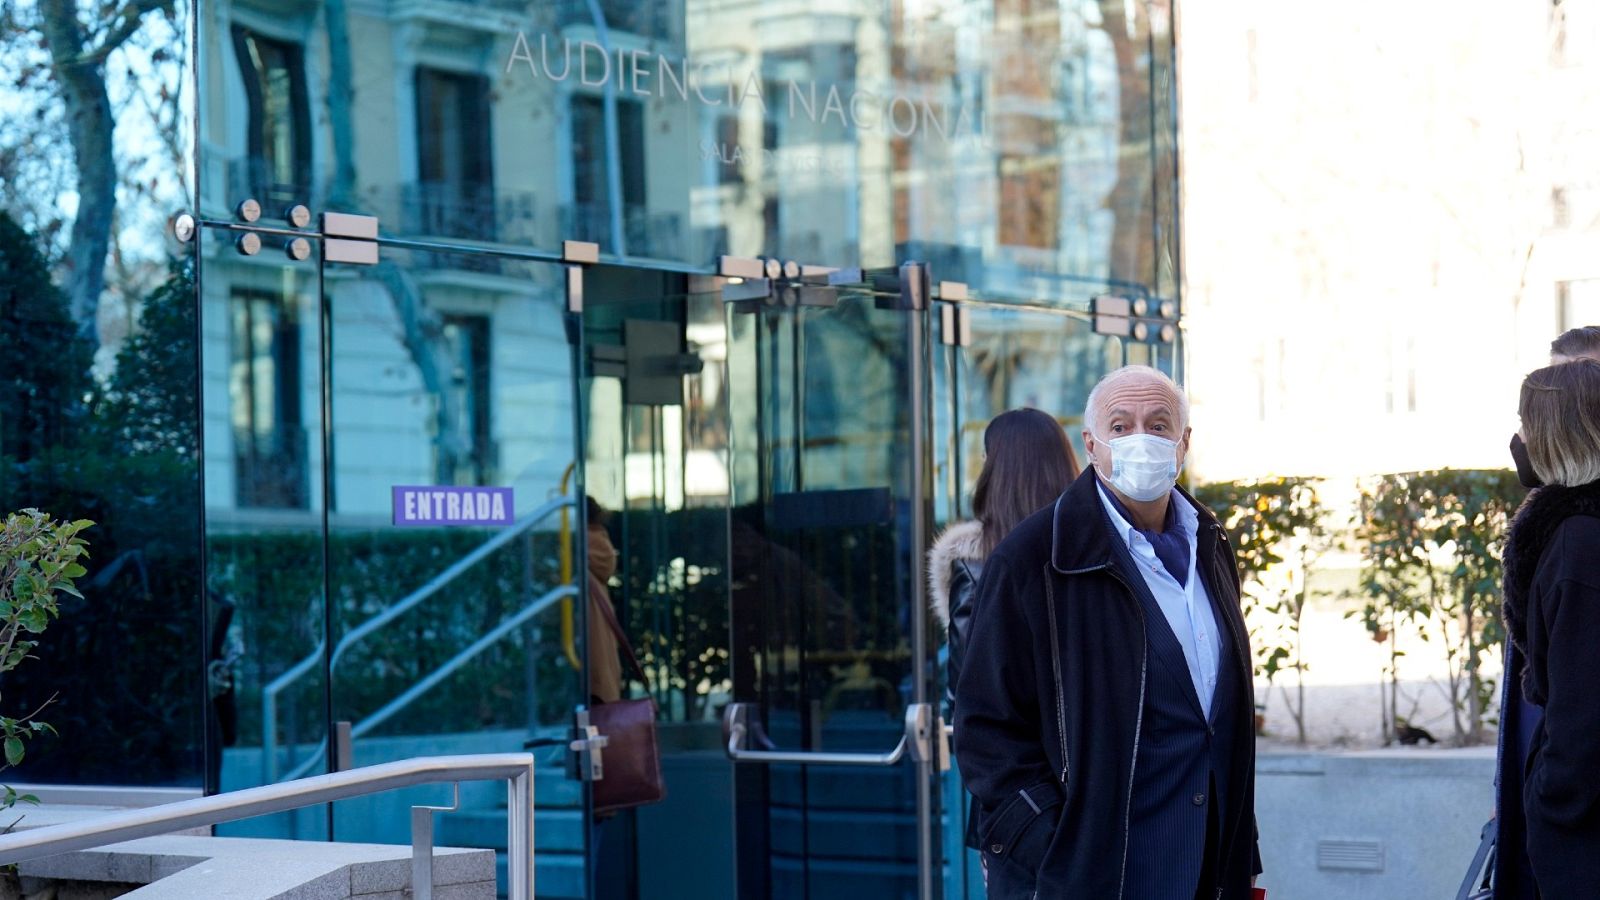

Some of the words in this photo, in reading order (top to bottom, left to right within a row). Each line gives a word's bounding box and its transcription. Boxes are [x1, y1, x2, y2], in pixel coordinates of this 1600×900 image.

[506, 30, 768, 114] AUDIENCIA
[788, 79, 994, 151] NACIONAL
[404, 491, 505, 520] ENTRADA
